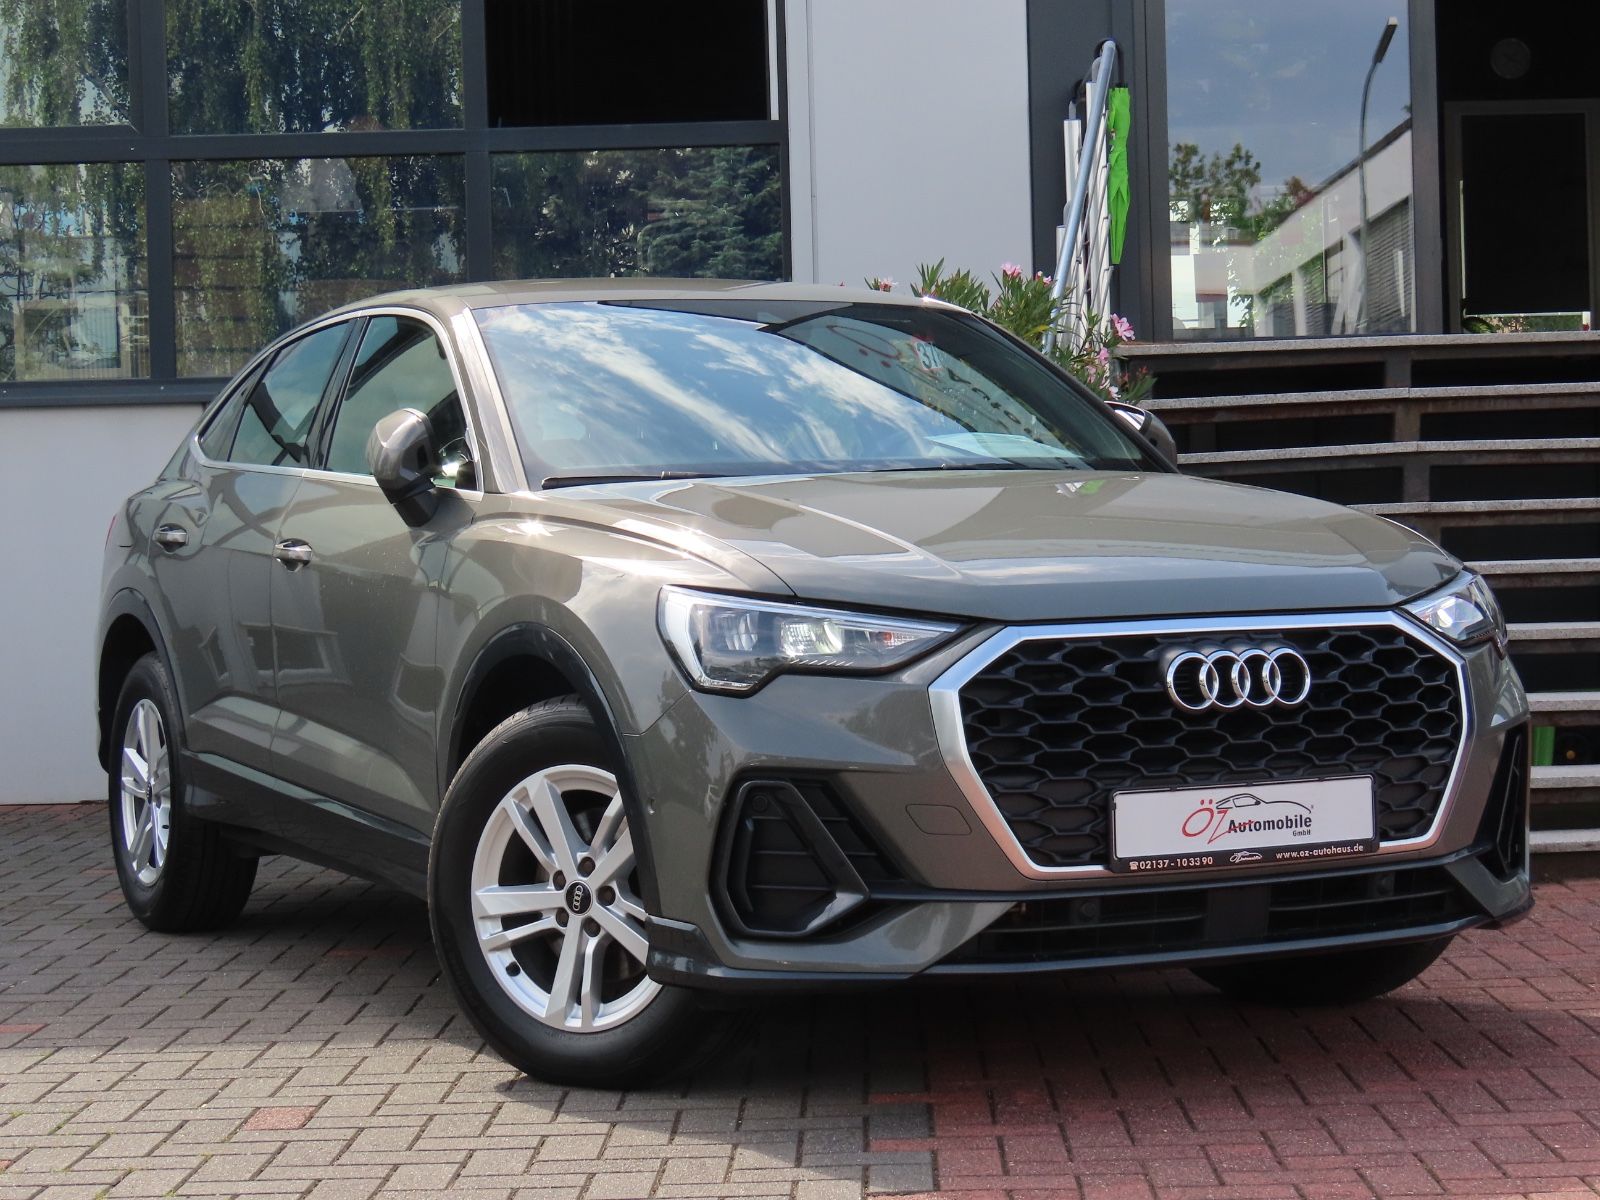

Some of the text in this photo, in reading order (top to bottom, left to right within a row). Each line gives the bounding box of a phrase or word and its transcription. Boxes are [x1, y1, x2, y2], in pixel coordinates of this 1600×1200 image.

[1228, 814, 1312, 833] Automobile
[1292, 829, 1311, 837] GmbH
[1276, 843, 1364, 858] www.oz-autohaus.de
[1140, 860, 1169, 869] 02137
